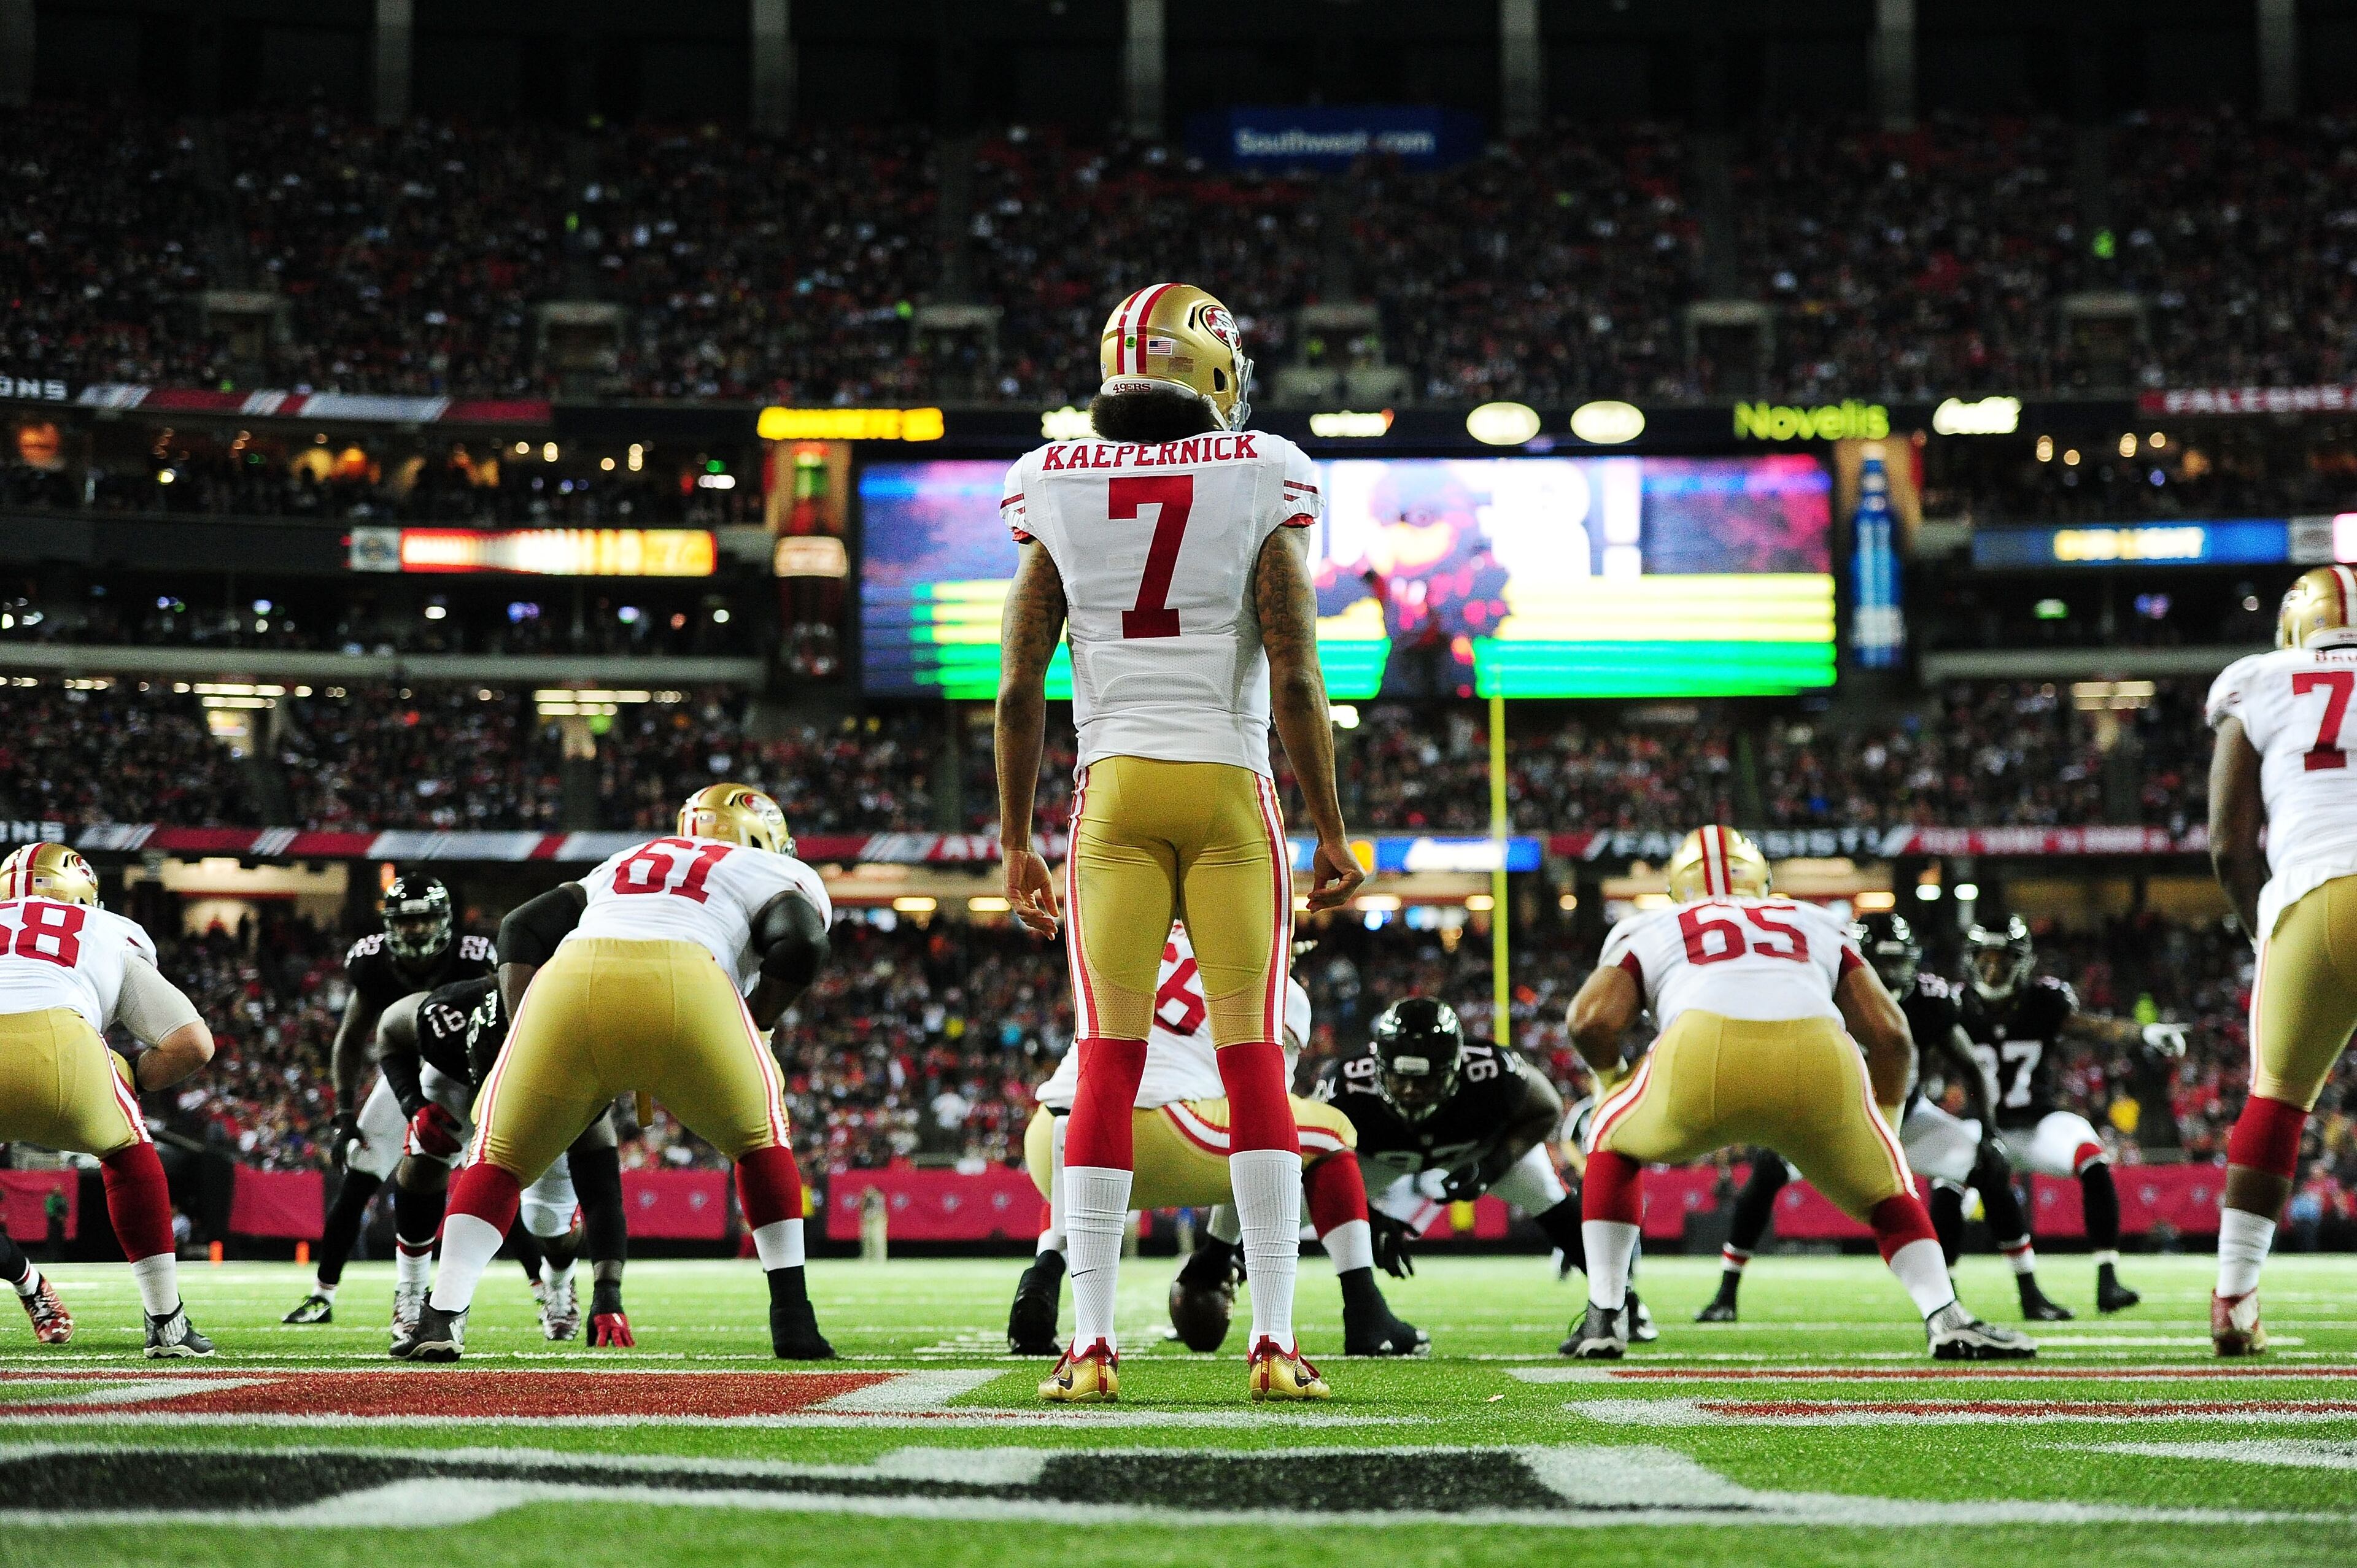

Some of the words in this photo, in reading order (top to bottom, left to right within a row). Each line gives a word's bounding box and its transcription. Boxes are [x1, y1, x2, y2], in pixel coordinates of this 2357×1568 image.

[1113, 382, 1151, 393] 49ERS
[1734, 399, 1889, 441] Novelis
[1042, 435, 1257, 470] KAEPERNICK
[1109, 474, 1193, 638] 7
[613, 838, 734, 904] 61
[1678, 901, 1809, 965] 65
